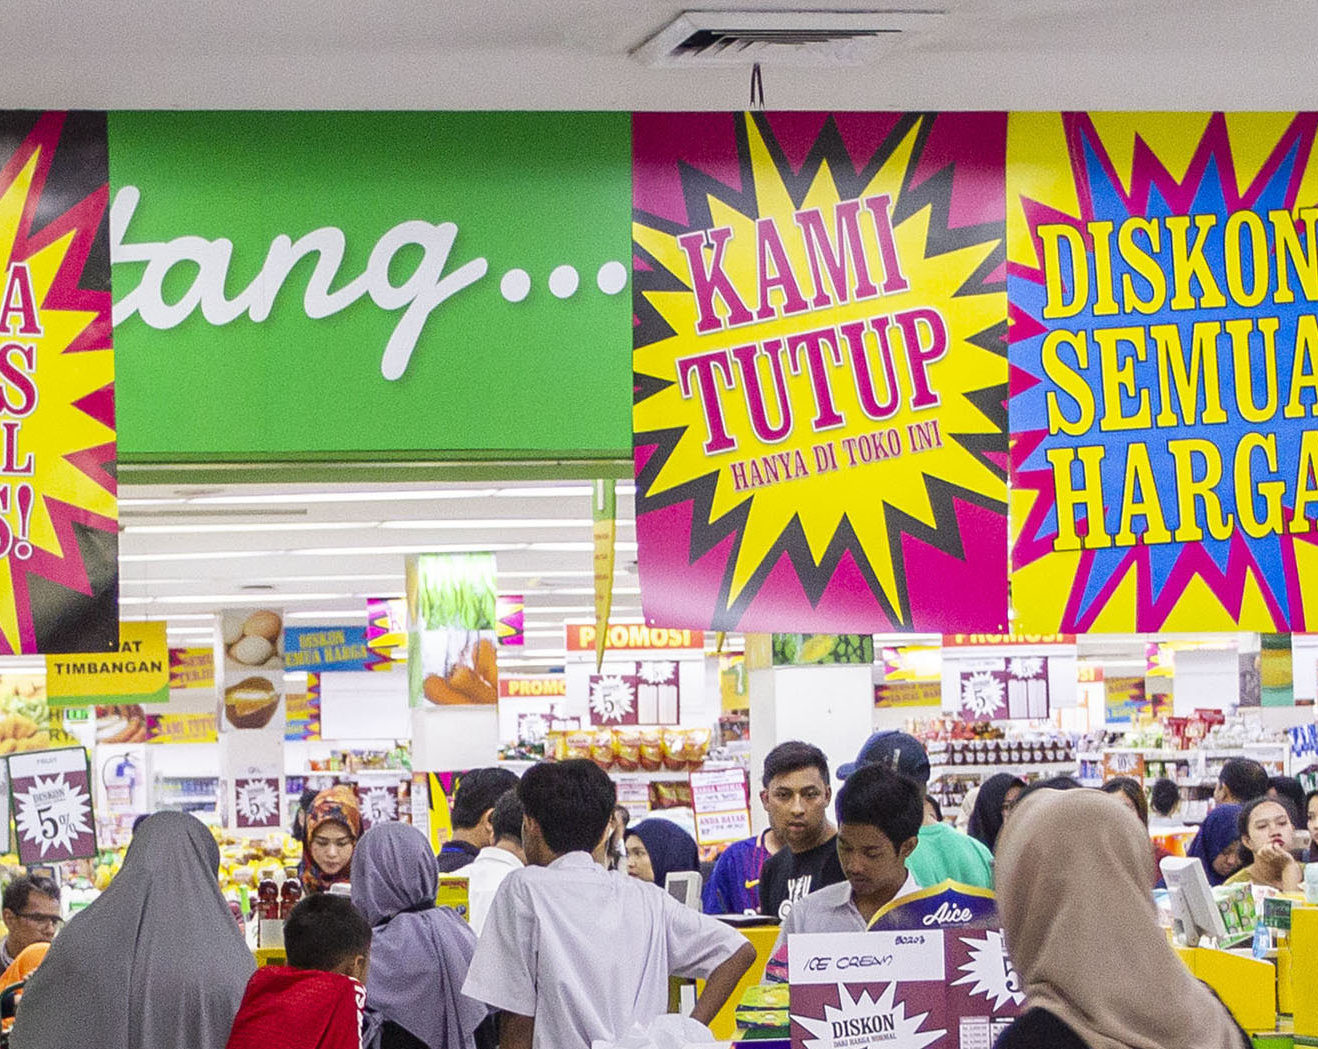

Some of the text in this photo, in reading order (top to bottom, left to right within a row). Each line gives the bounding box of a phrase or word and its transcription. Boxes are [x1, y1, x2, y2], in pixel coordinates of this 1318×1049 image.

[678, 193, 910, 337] KAMI
[677, 305, 949, 457] TUTUP
[729, 419, 944, 494] HANYA DI TOKO INI
[299, 631, 346, 649] DISKON
[579, 625, 691, 648] POMOSI
[54, 661, 163, 675] TIMBANGAN
[37, 804, 76, 840] 5%
[923, 902, 973, 926] Aice
[803, 954, 893, 972] ICE CREAM
[832, 1013, 895, 1039] DISKON
[833, 1033, 897, 1048] DARI HARGA NORMAL
